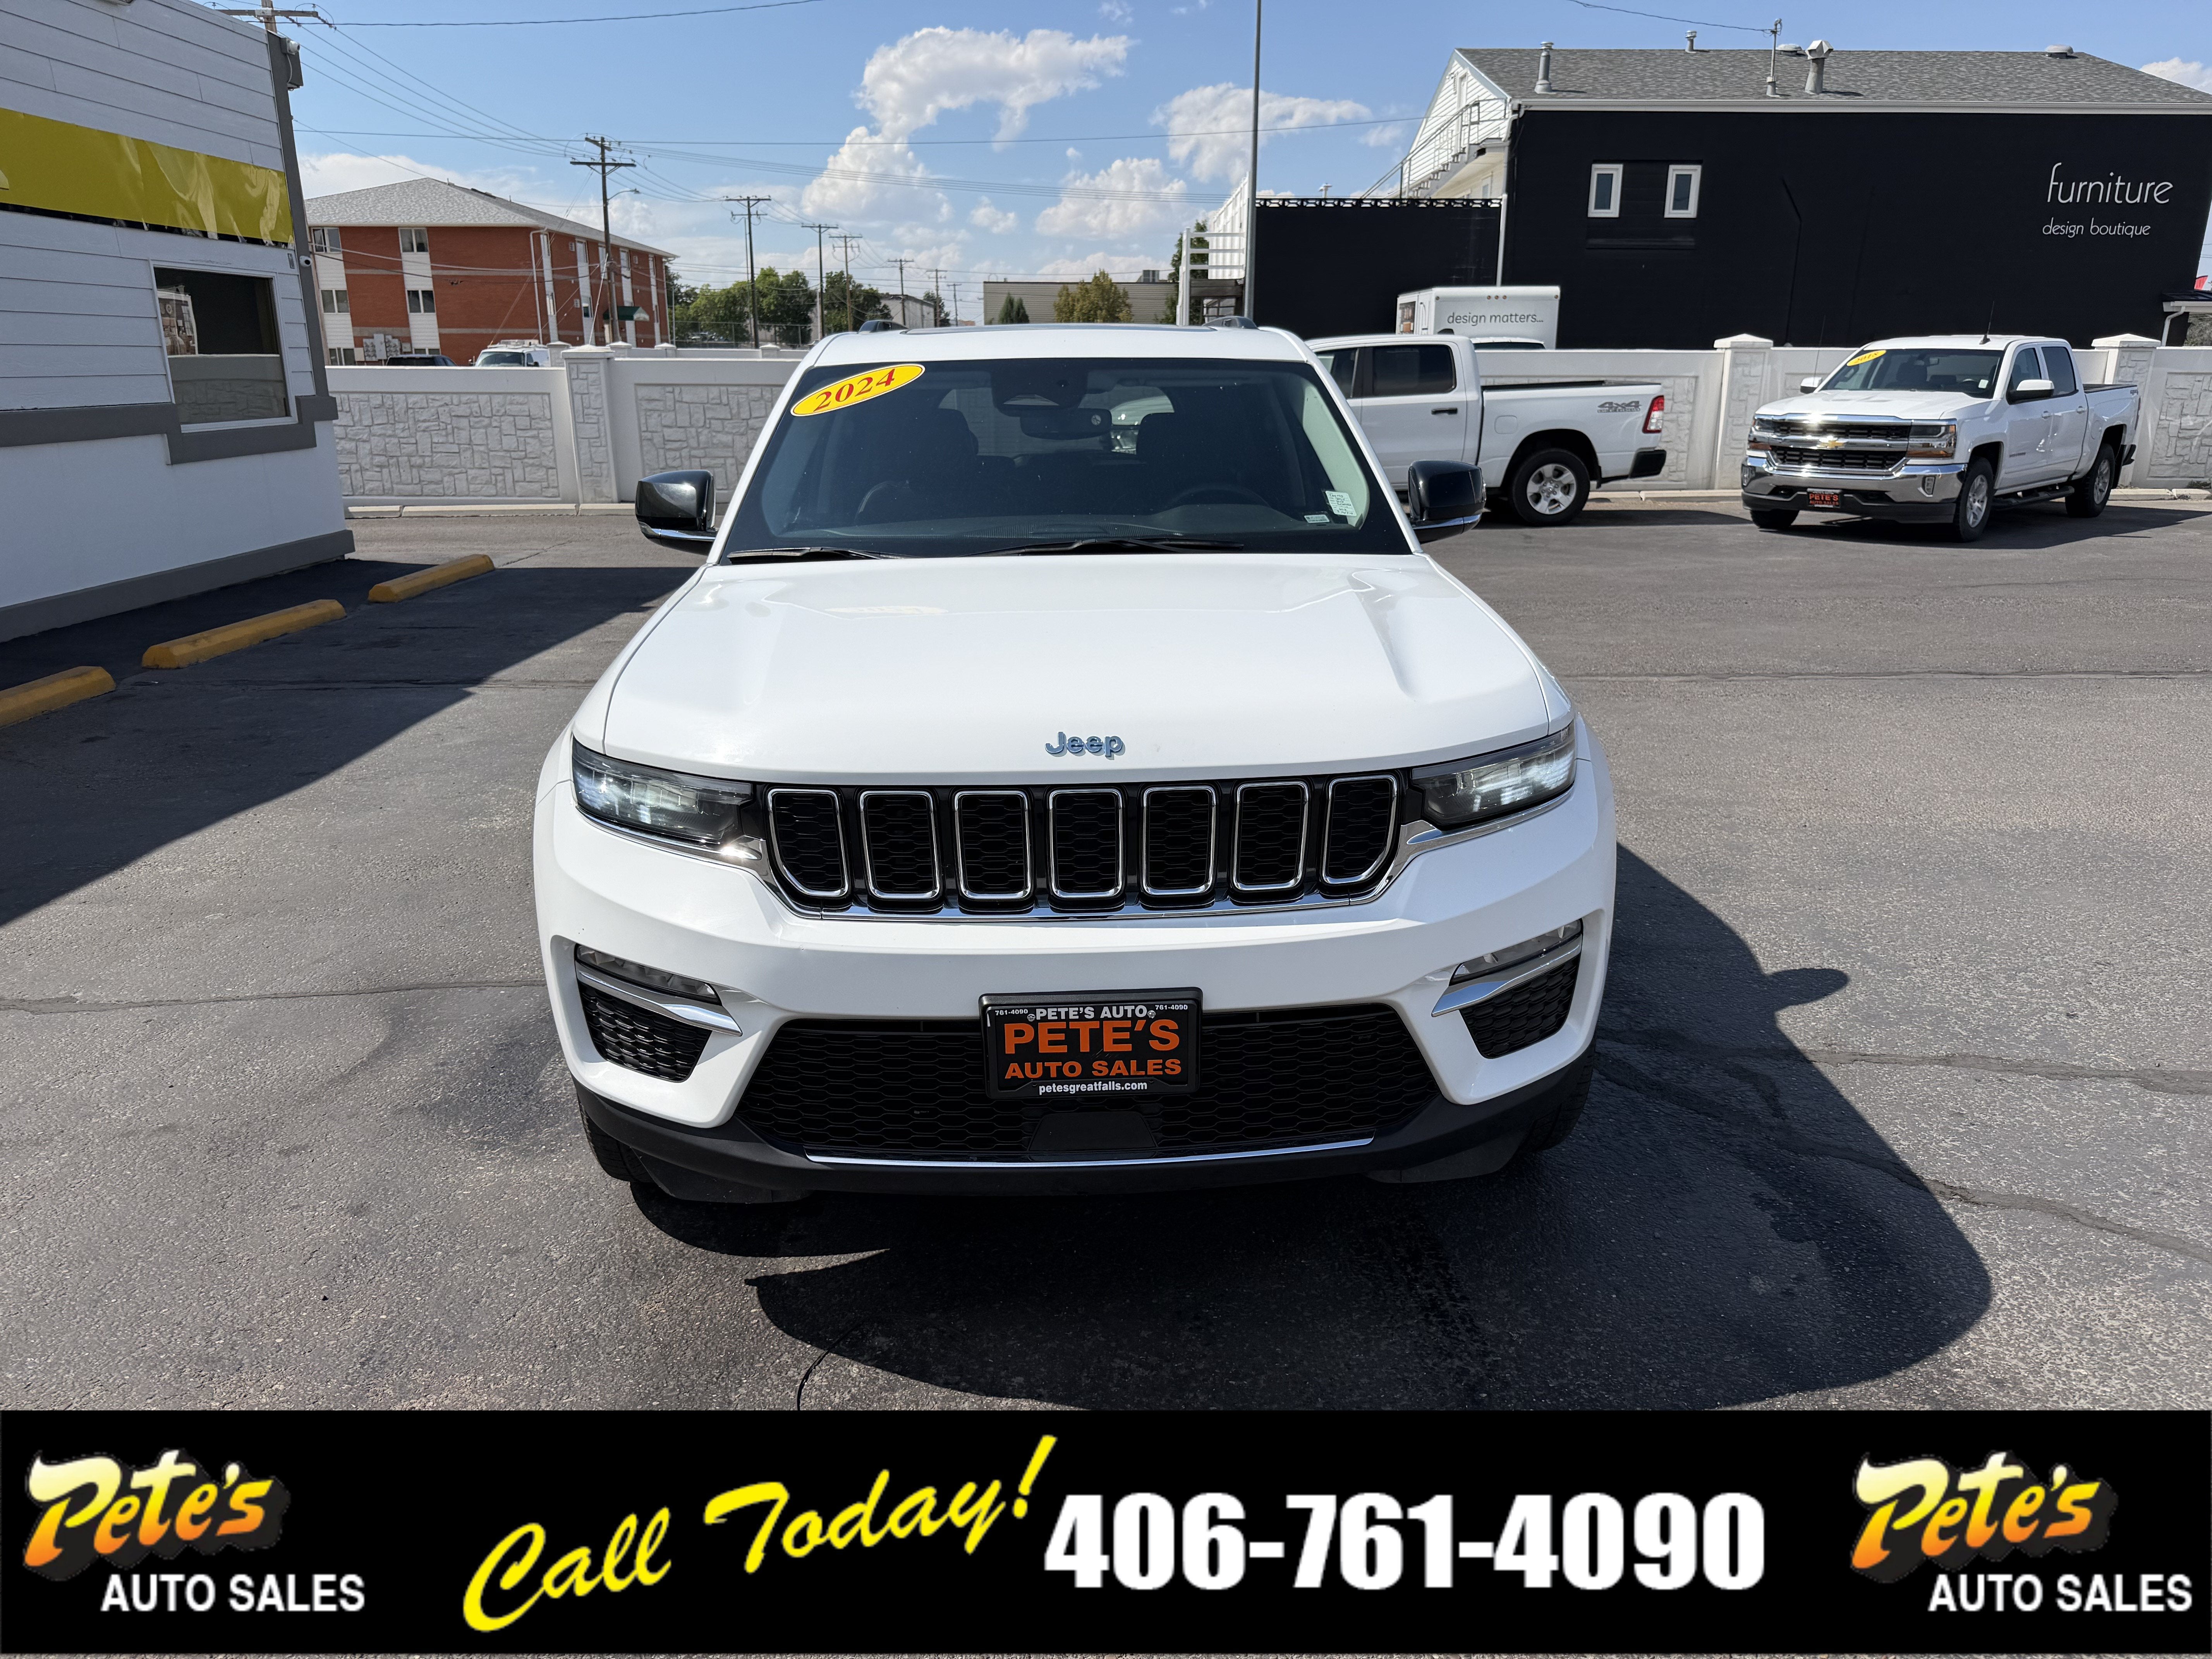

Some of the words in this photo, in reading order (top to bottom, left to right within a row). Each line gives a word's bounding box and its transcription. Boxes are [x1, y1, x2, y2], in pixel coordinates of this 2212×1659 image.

[2047, 162, 2174, 204] furniture
[2042, 217, 2084, 238] design
[2090, 217, 2151, 238] boutique
[1447, 312, 1486, 326] design
[1490, 313, 1544, 323] matters...
[813, 368, 895, 412] 2024
[1809, 493, 1839, 501] PETE'S
[1045, 732, 1124, 759] Jeep
[1036, 1006, 1095, 1020] PETE'S
[1100, 1005, 1147, 1018] AUTO
[1004, 1019, 1180, 1054] PETE'S
[1005, 1061, 1082, 1079] AUTO
[1092, 1059, 1182, 1077] SALES
[1039, 1081, 1148, 1095] petesgreatfalls.com
